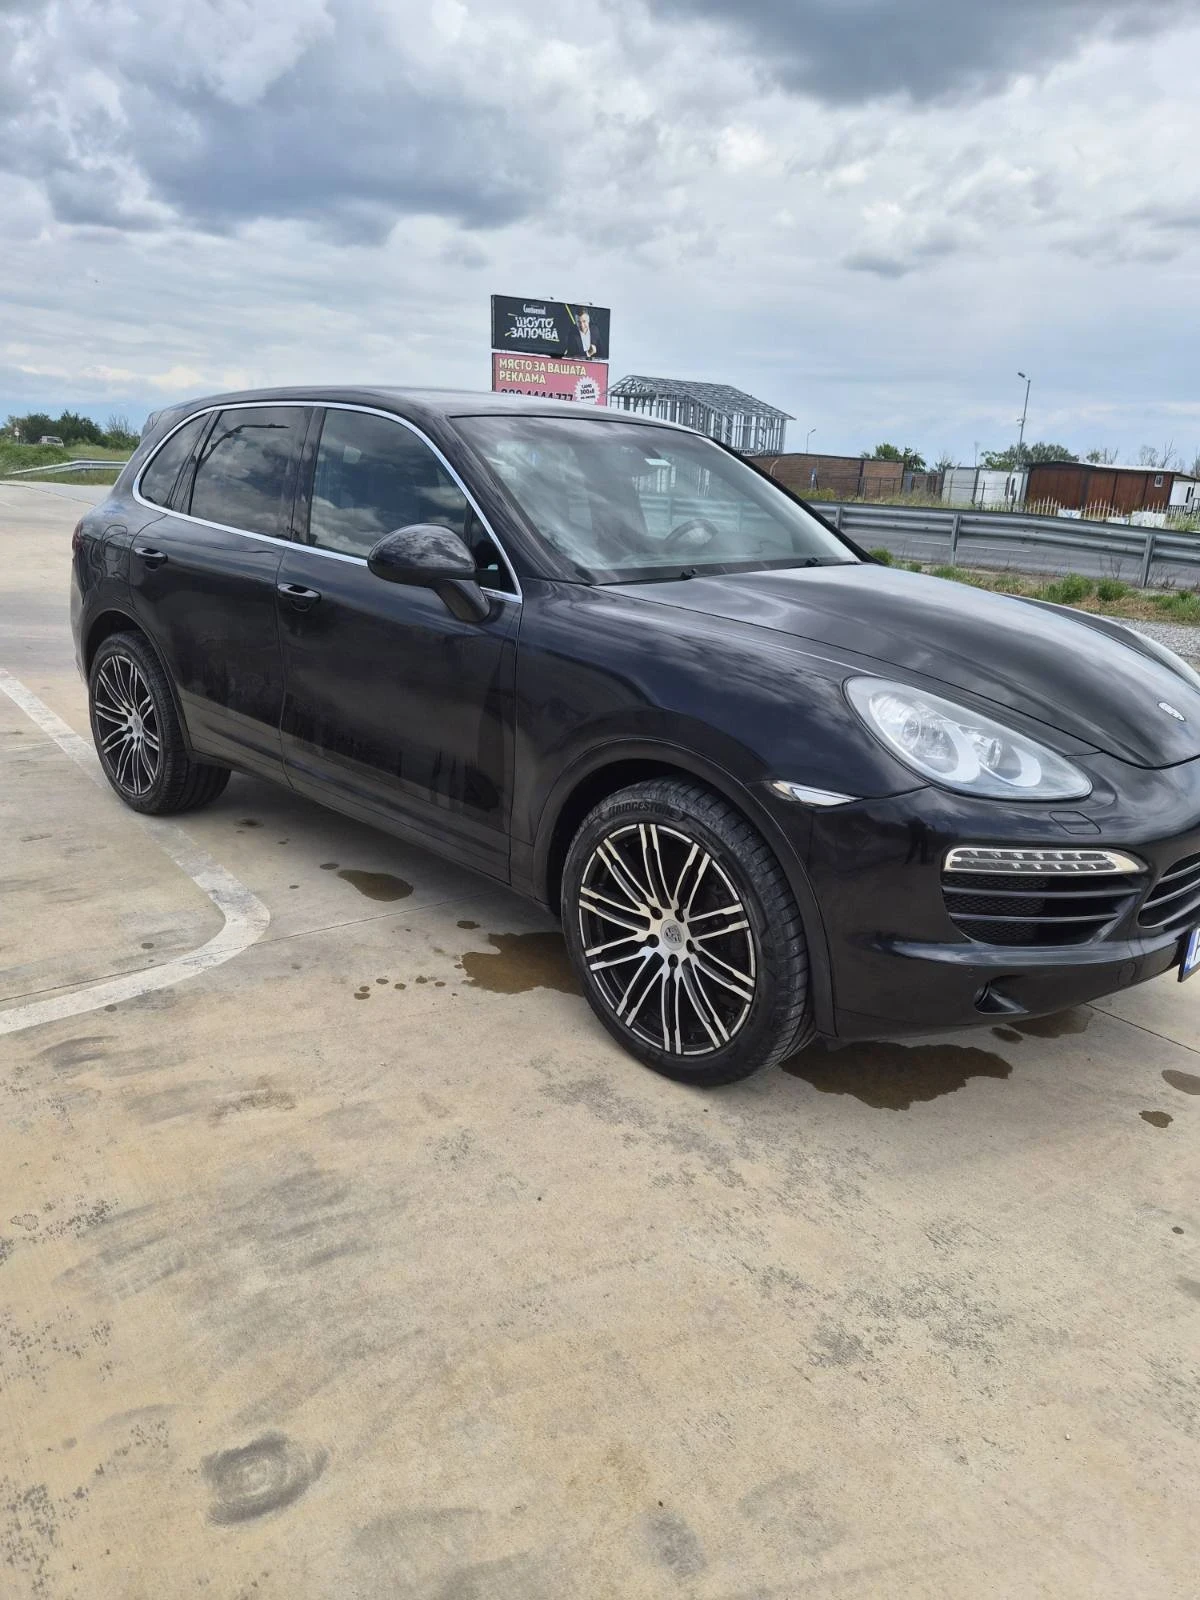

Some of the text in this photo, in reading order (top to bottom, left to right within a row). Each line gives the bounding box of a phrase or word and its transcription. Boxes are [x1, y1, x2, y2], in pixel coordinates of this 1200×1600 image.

[515, 317, 553, 328] ШОУТО
[510, 327, 558, 340] ЗАПОЧВА
[499, 359, 586, 376] МЯСТО ЗА ВАШАТА
[499, 371, 546, 384] РЕКЛАМА
